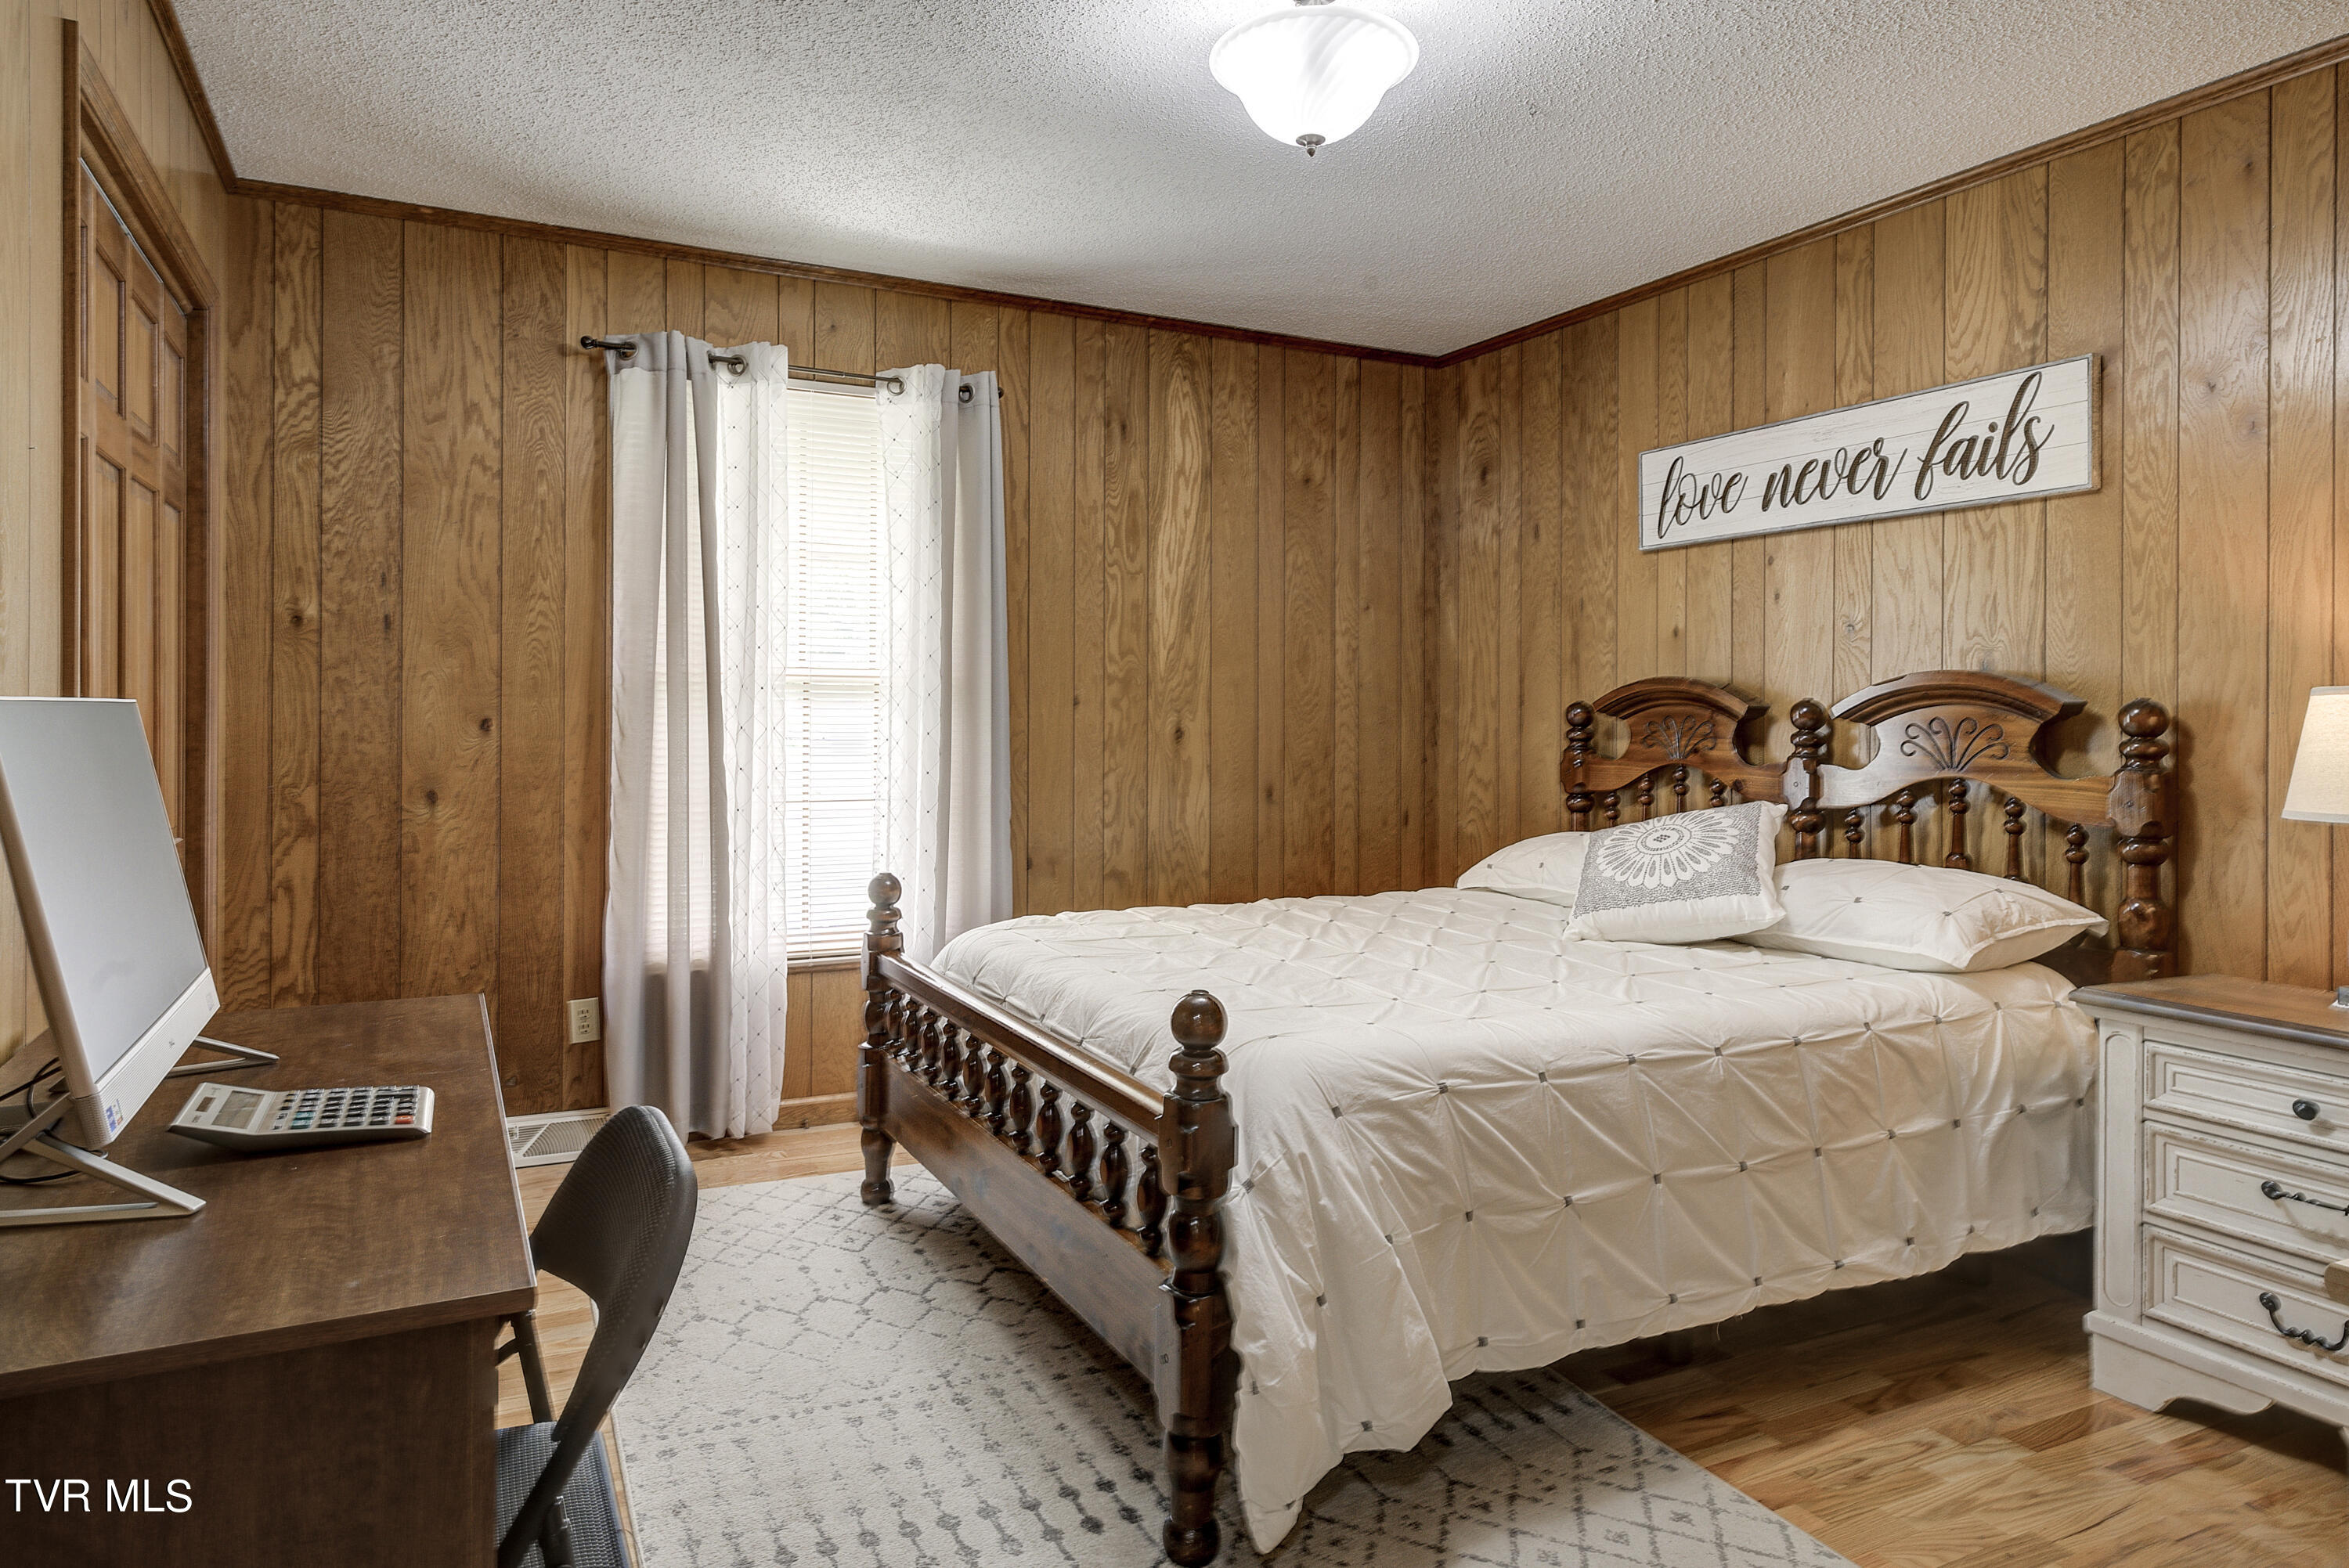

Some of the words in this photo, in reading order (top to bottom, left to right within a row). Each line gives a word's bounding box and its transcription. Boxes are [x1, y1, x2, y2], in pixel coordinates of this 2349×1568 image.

[1658, 456, 1748, 539] love
[1762, 438, 1908, 512] never
[1915, 371, 2055, 500] fails
